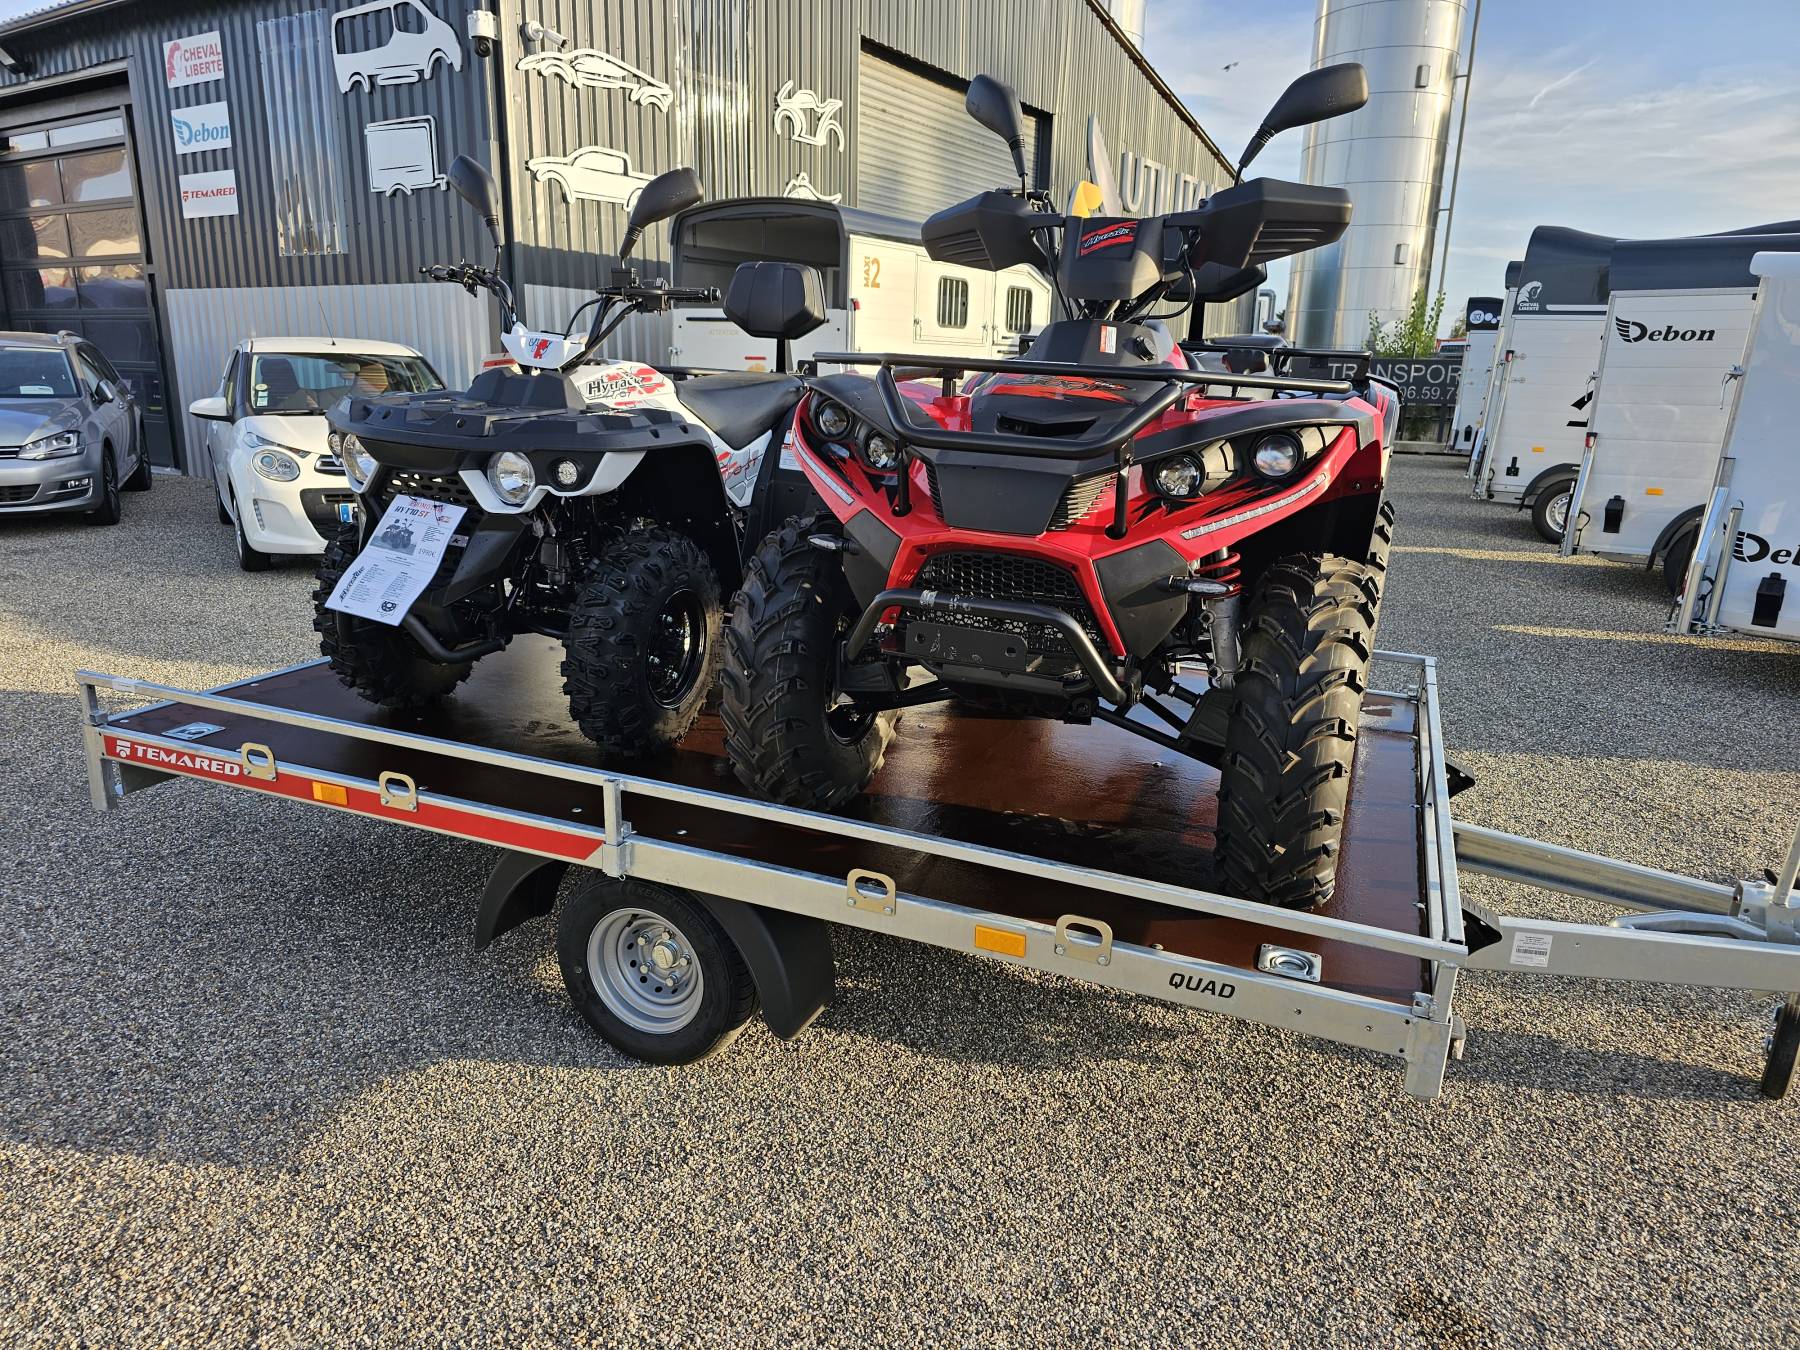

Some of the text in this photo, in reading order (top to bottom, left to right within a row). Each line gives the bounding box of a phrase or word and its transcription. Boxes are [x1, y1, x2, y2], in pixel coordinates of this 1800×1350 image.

[183, 43, 221, 62] CHEVAL
[173, 115, 230, 147] Debon
[190, 186, 236, 199] TEMARED
[863, 256, 871, 288] MAXI
[871, 257, 881, 289] 2
[1615, 316, 1716, 344] Debon
[588, 375, 642, 396] Hytrack
[134, 744, 240, 776] TEMARED
[1168, 972, 1236, 999] QUAD
